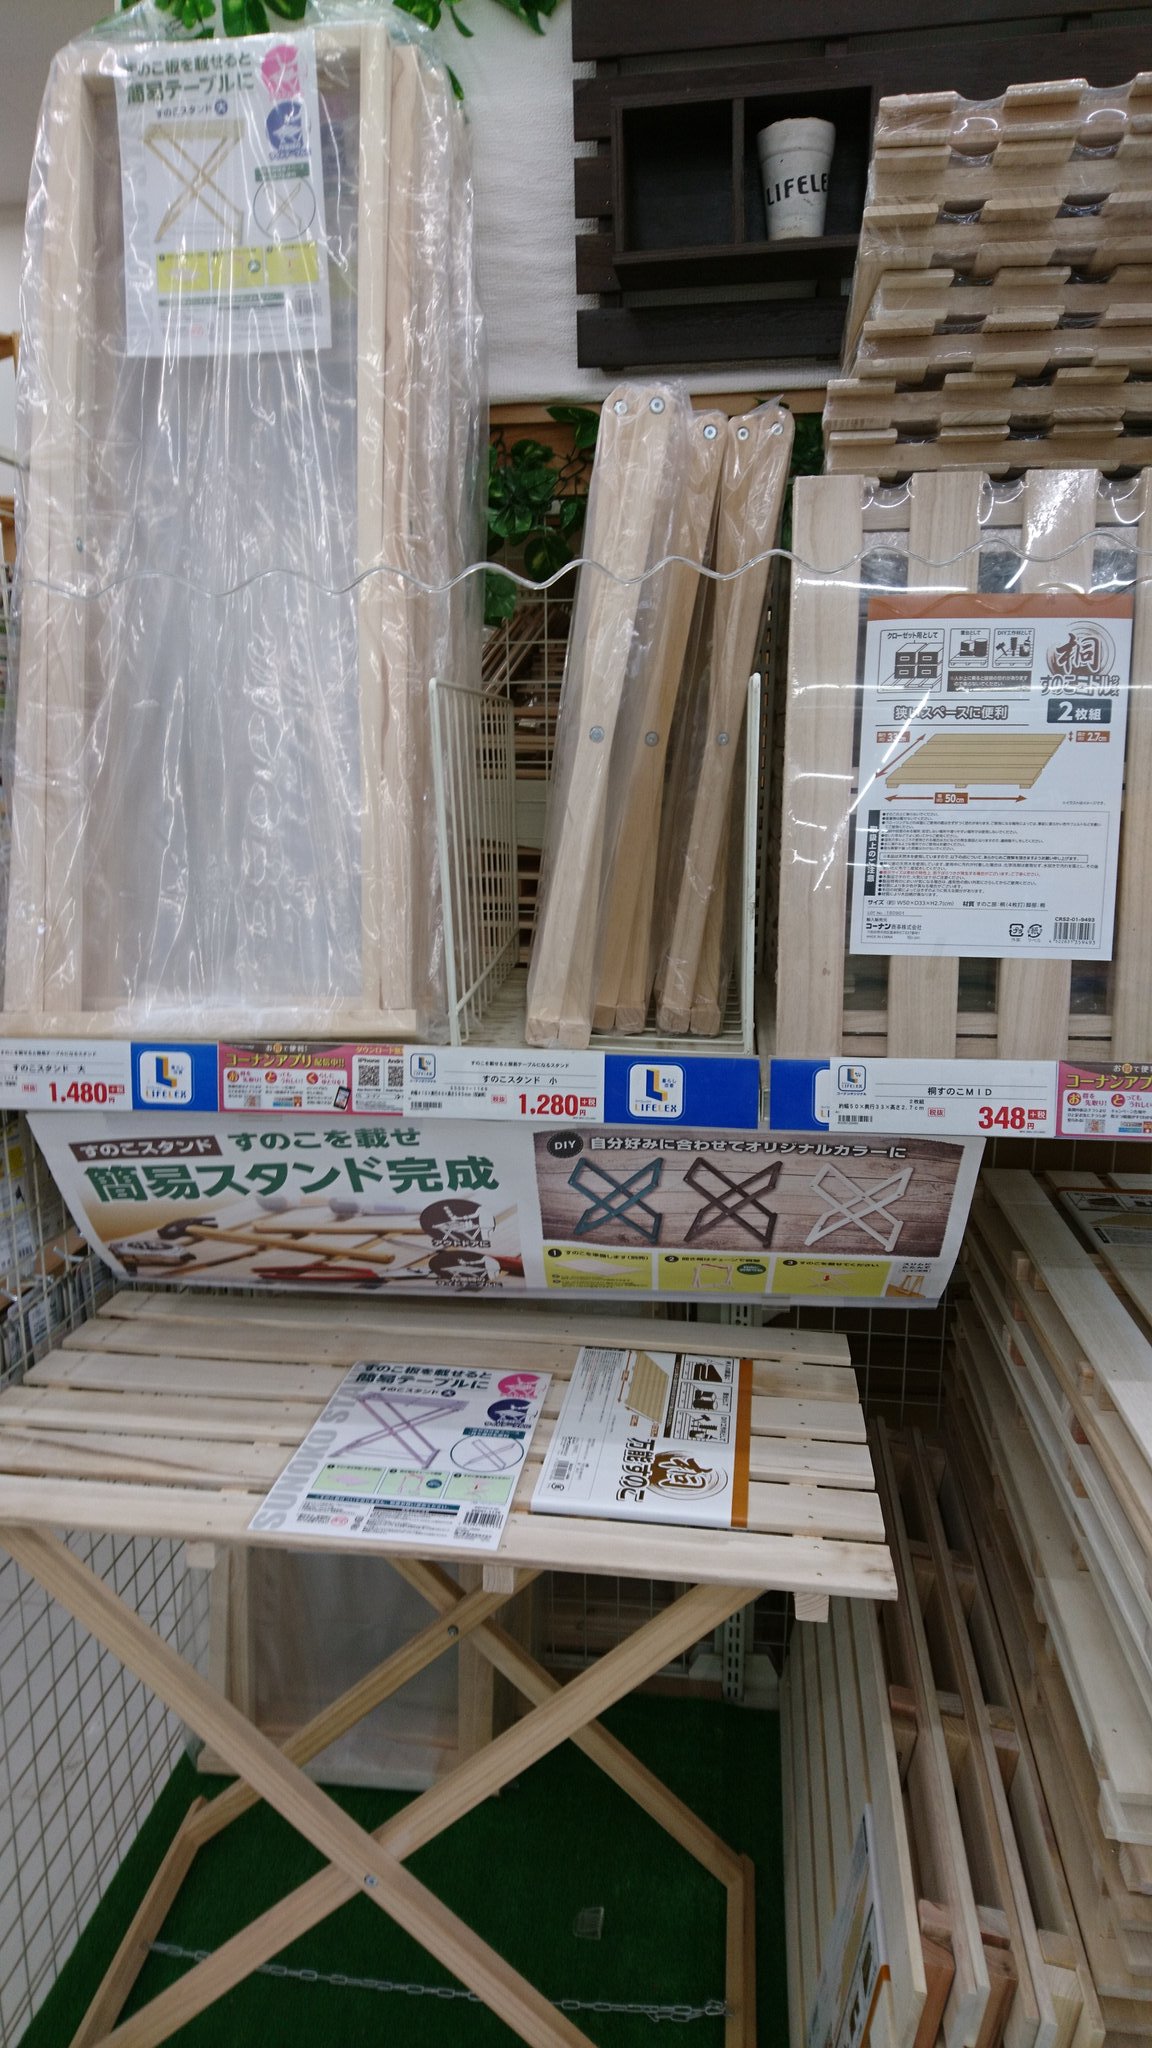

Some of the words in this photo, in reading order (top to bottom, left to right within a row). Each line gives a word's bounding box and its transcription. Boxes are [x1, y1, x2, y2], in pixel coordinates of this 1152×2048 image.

[887, 632, 939, 640] クローゼット用として
[1056, 633, 1102, 675] 桐
[894, 705, 1009, 720] 狭いスペースに便利
[1057, 701, 1102, 720] 2枚組
[945, 793, 965, 803] 50cm
[14, 1064, 68, 1073] すのこスタンド
[226, 1054, 313, 1068] コーナンアプリ
[483, 1075, 540, 1085] すのこスタンド
[549, 1077, 557, 1085] 小
[928, 1087, 993, 1096] 桐すのこMID
[635, 1103, 677, 1113] LIFELEX
[928, 1108, 945, 1117] 税抜
[1028, 1110, 1047, 1120] +税
[978, 1106, 1026, 1130] 348
[80, 1138, 212, 1158] すのこスタンド
[227, 1127, 421, 1151] すのこを載せ
[554, 1141, 576, 1150] DIY
[590, 1137, 907, 1159] 自分好みに合わせてオリジナルカラーに
[84, 1155, 500, 1202] 簡易スタンド完成
[364, 1362, 493, 1380] すのこ板を載せると
[355, 1373, 491, 1390] 簡易テーブルに
[380, 1386, 439, 1395] すのこスタンド
[616, 1437, 656, 1503] 万能すのこ
[657, 1456, 713, 1488] 桐
[252, 1429, 338, 1529] SUNOKO
